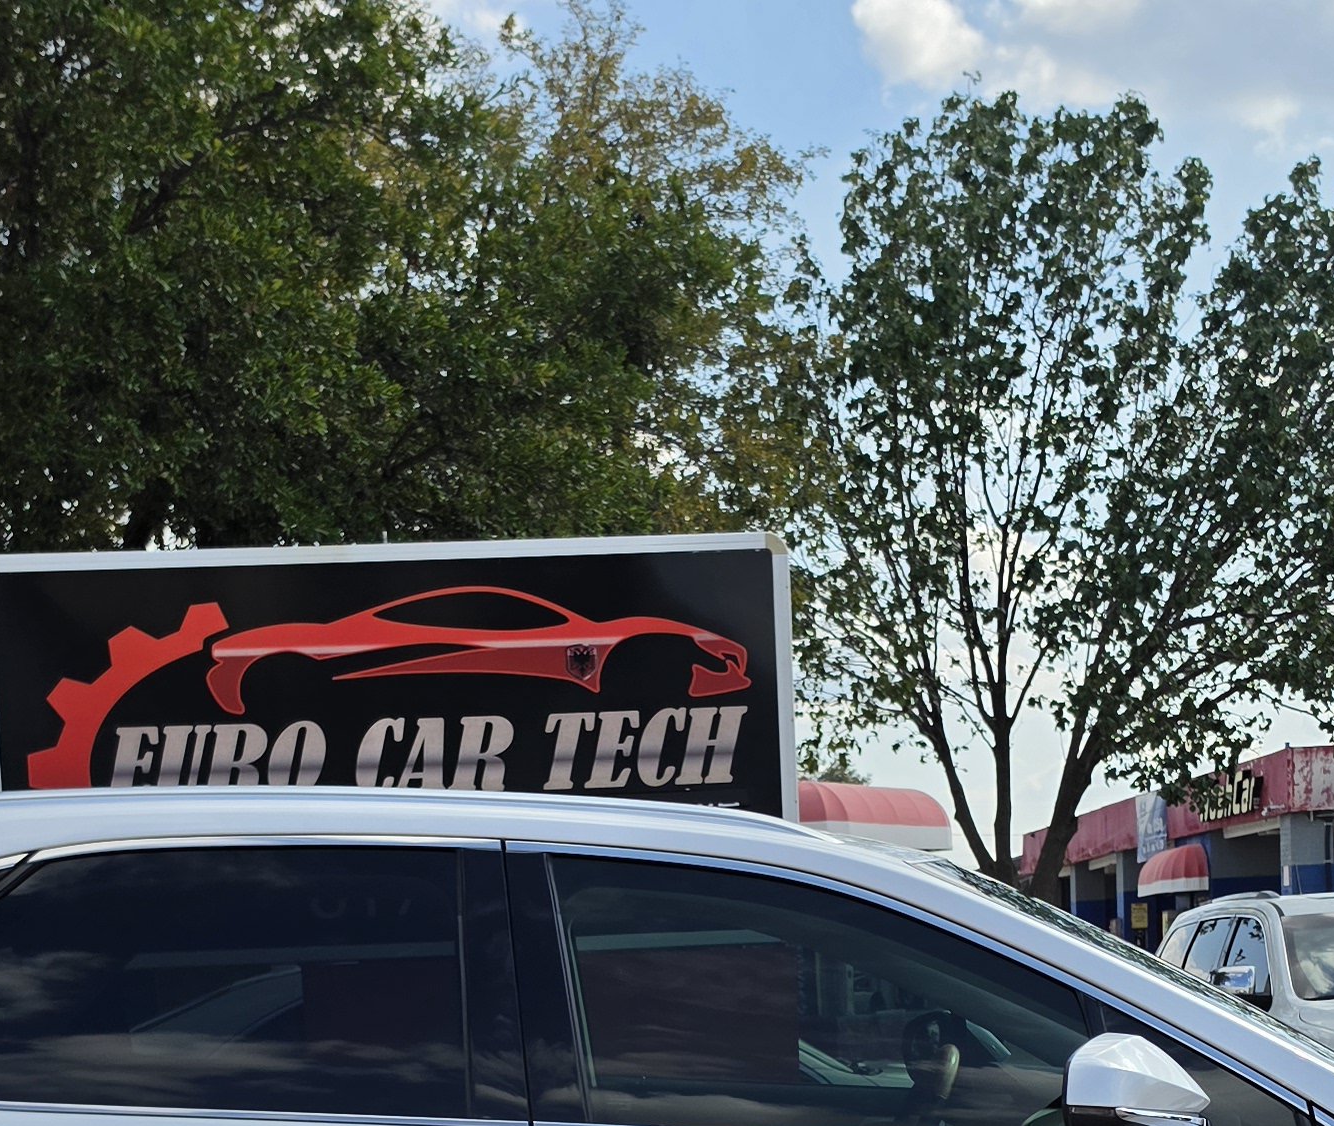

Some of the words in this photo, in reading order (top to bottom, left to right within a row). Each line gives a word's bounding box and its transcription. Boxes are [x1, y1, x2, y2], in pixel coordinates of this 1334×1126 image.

[110, 720, 327, 787] EURO
[355, 715, 515, 791] CAR
[543, 706, 748, 790] TECH
